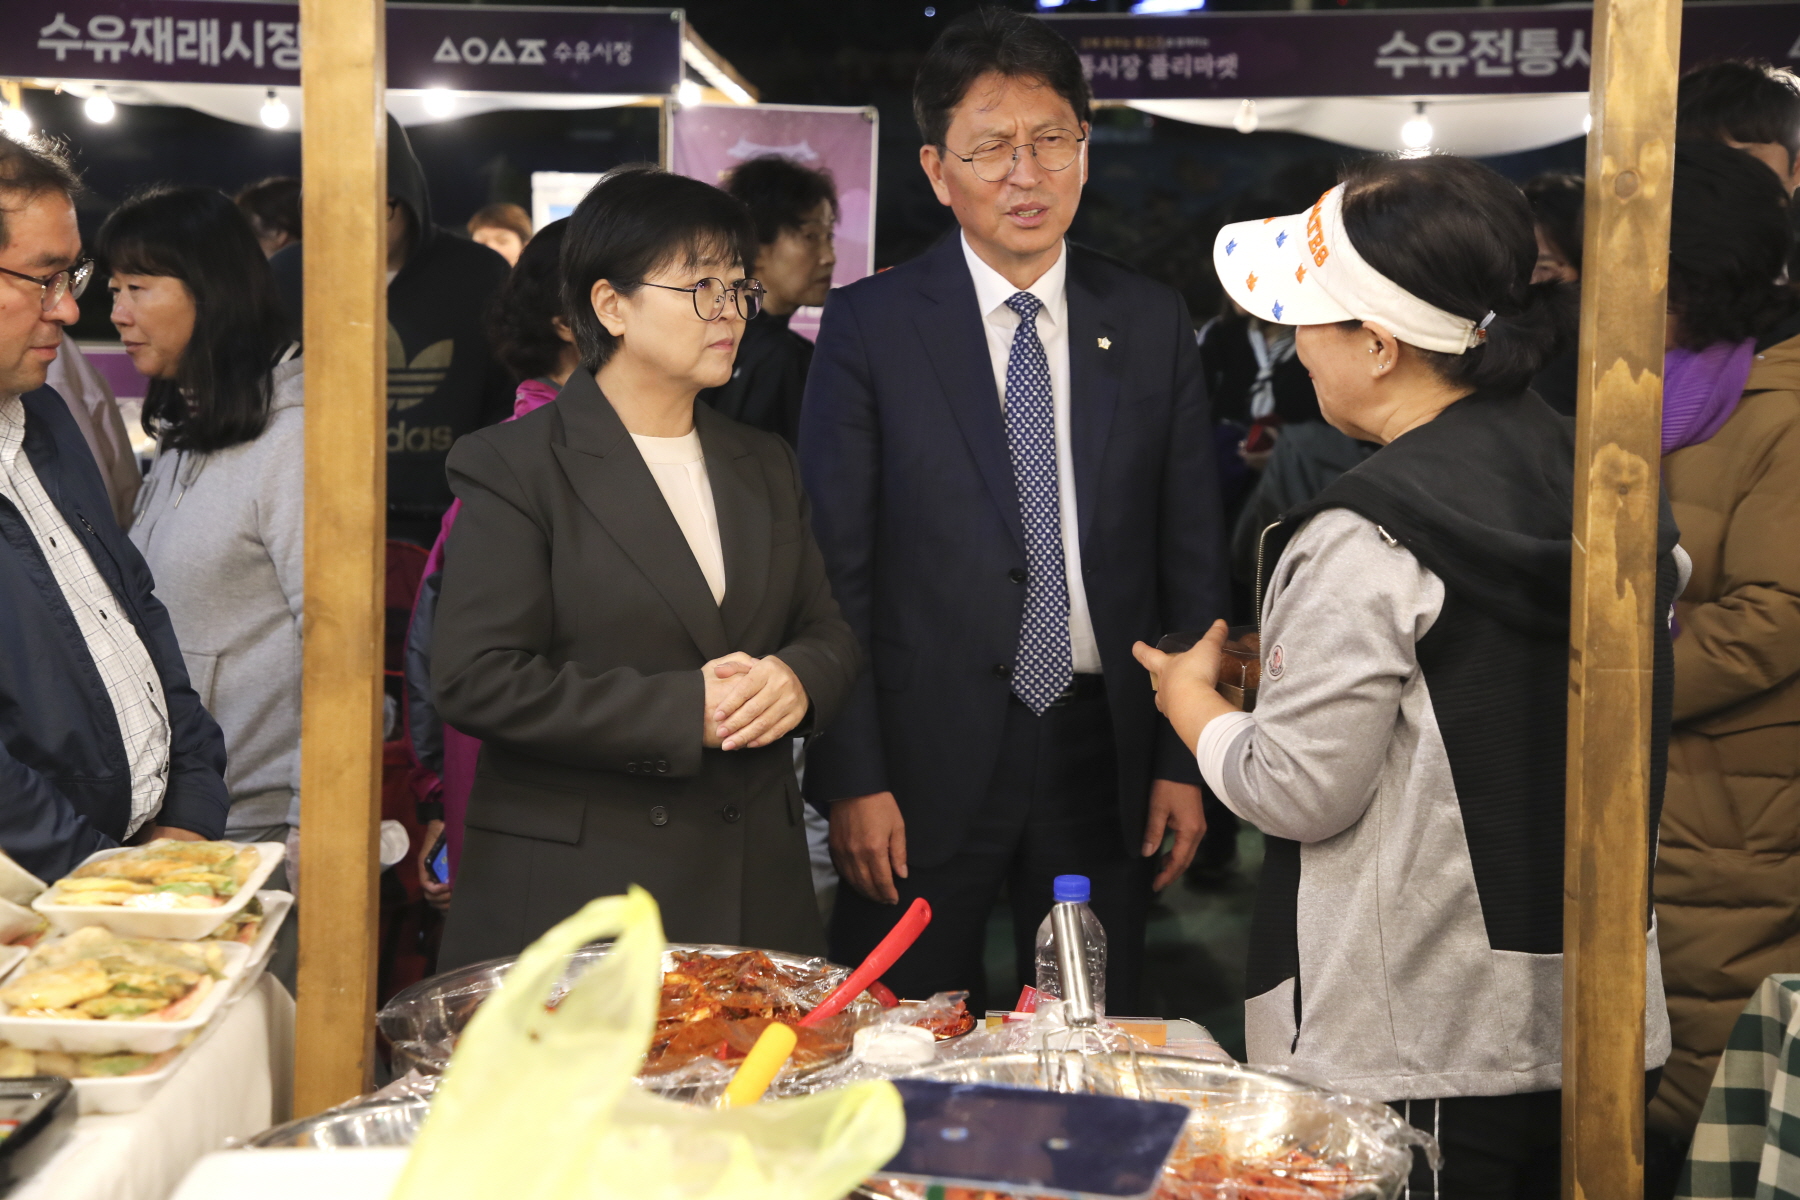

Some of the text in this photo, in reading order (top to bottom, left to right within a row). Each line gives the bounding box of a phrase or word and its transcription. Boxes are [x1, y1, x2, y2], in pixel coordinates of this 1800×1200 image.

[37, 12, 301, 70] 수유재래시장
[552, 40, 634, 67] 수유시장
[1148, 52, 1239, 80] 플리마켓
